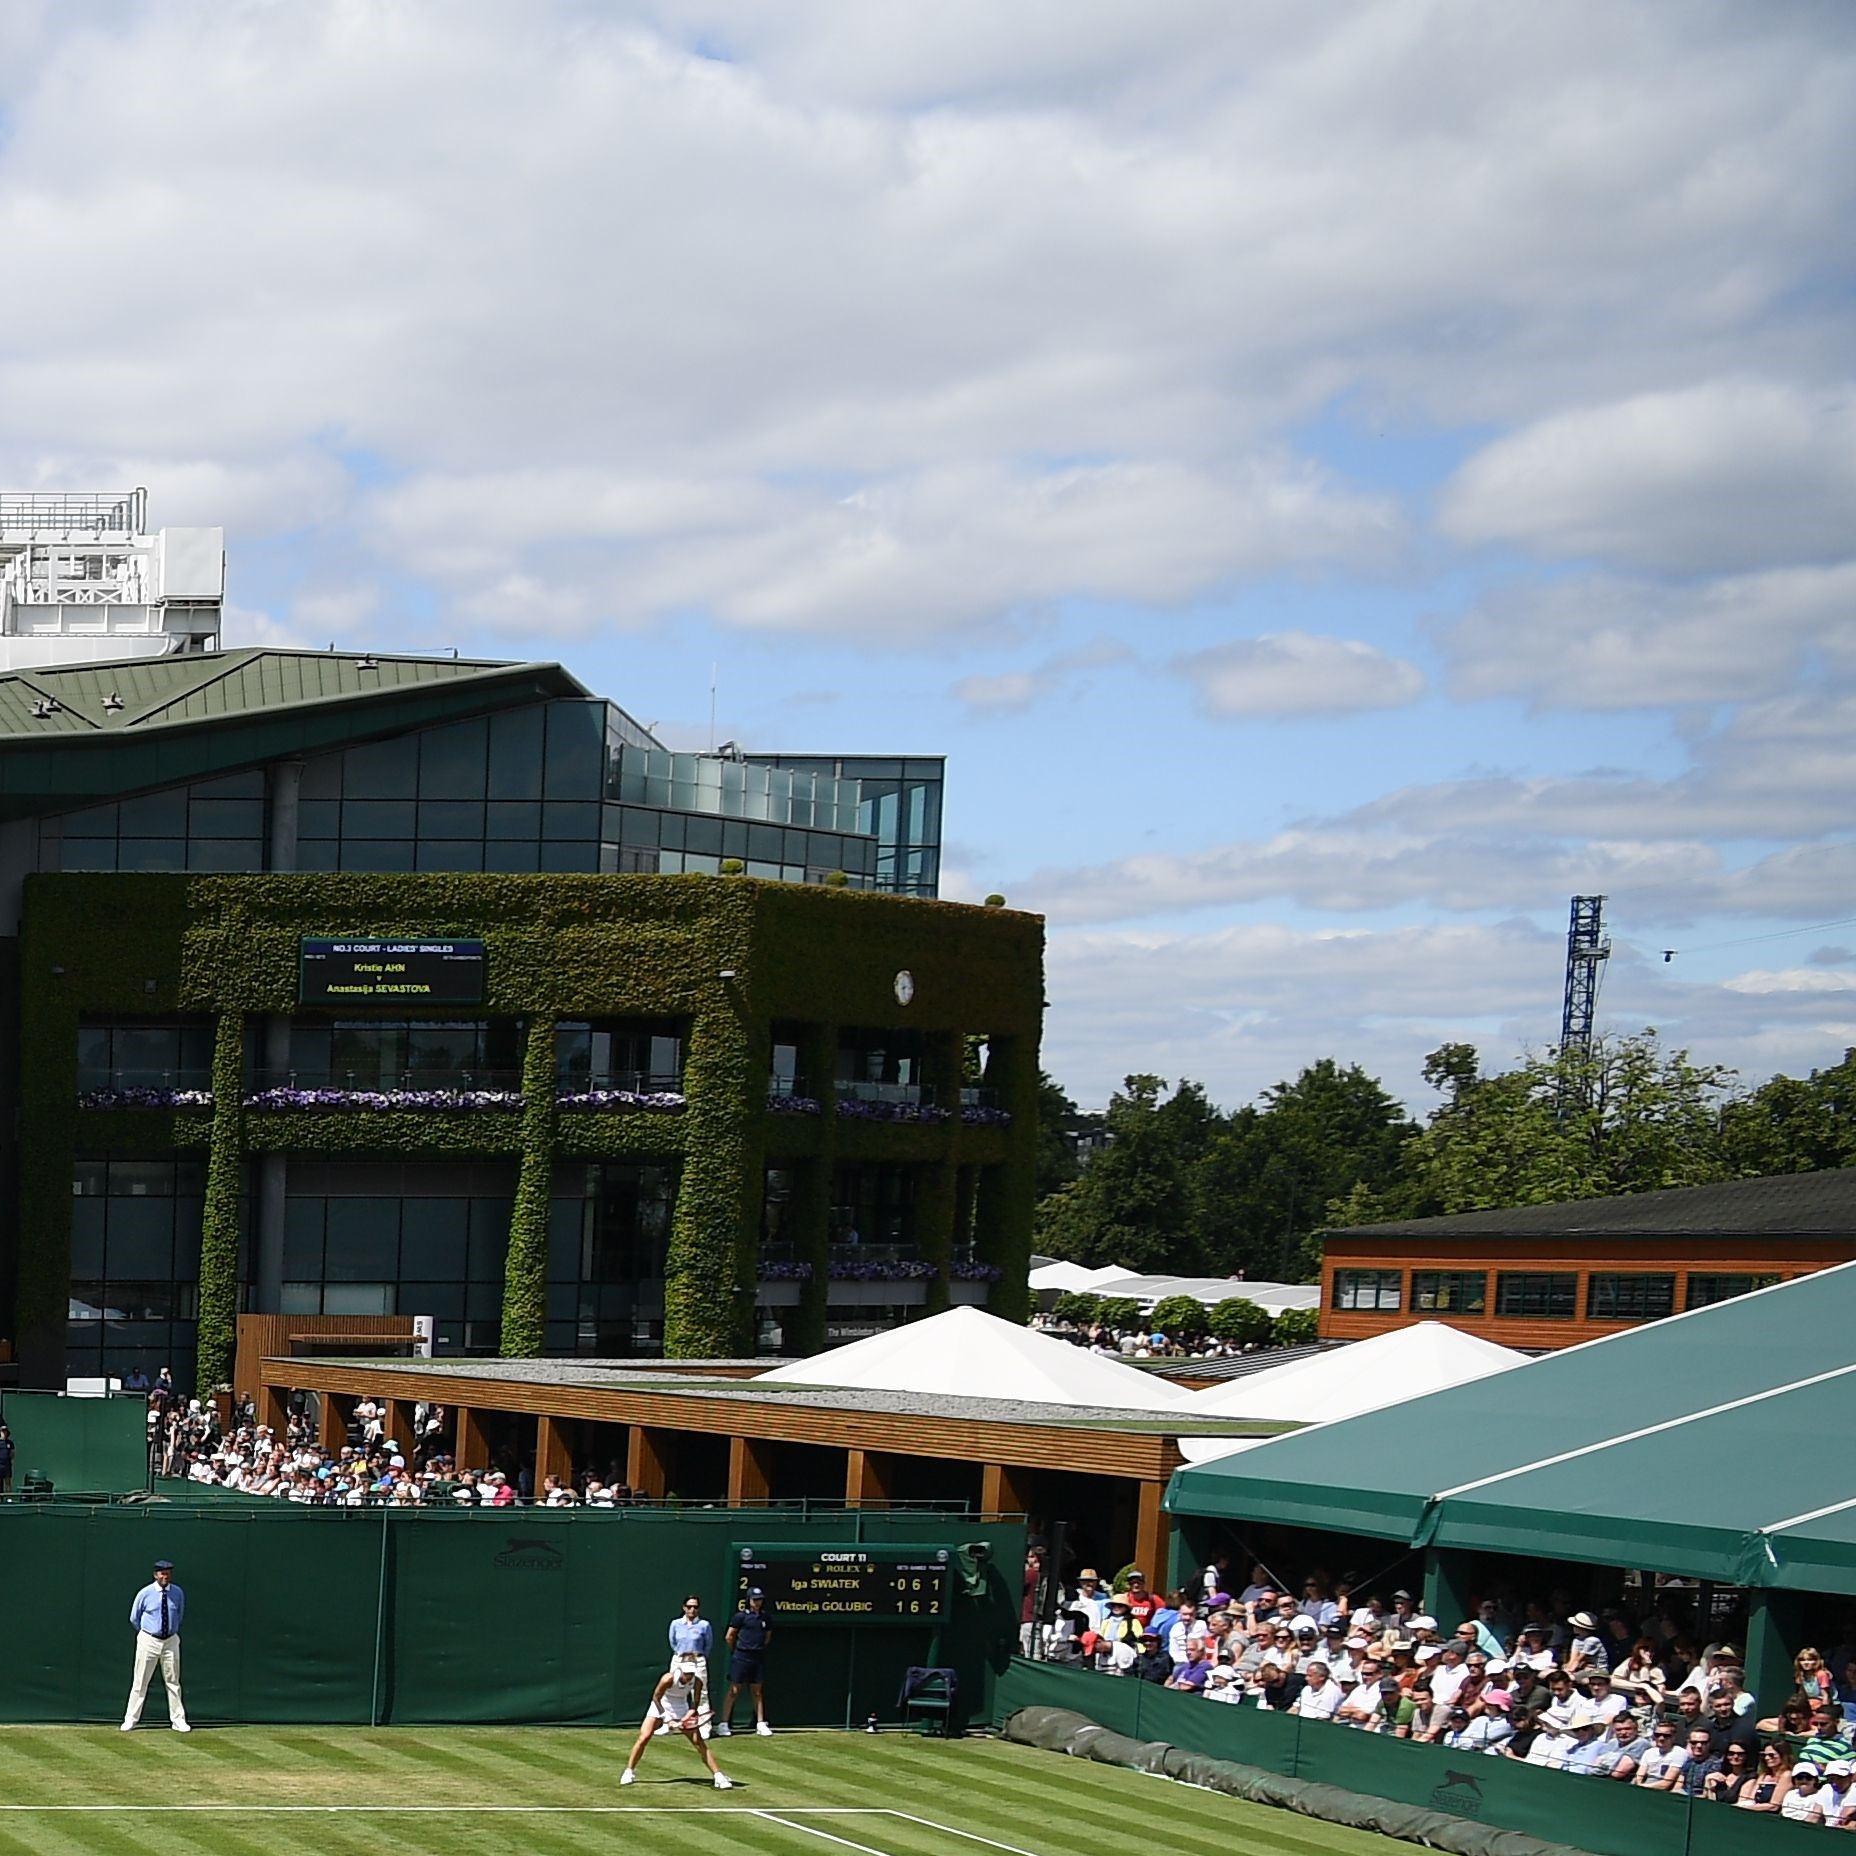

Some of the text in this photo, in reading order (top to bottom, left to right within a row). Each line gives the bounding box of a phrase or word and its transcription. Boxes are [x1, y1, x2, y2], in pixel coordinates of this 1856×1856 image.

[385, 964, 405, 972] AHN
[375, 985, 431, 993] SEVASTOVA
[821, 1553, 867, 1562] COURT 11
[826, 1565, 861, 1573] ROLEX
[740, 1578, 939, 1590] 2 Iga SWIATEK 0 6 1
[775, 1602, 819, 1612] Viktorija
[822, 1601, 873, 1611] GOLUBIC
[896, 1601, 902, 1612] 1
[911, 1601, 919, 1612] 6
[930, 1601, 938, 1613] 2
